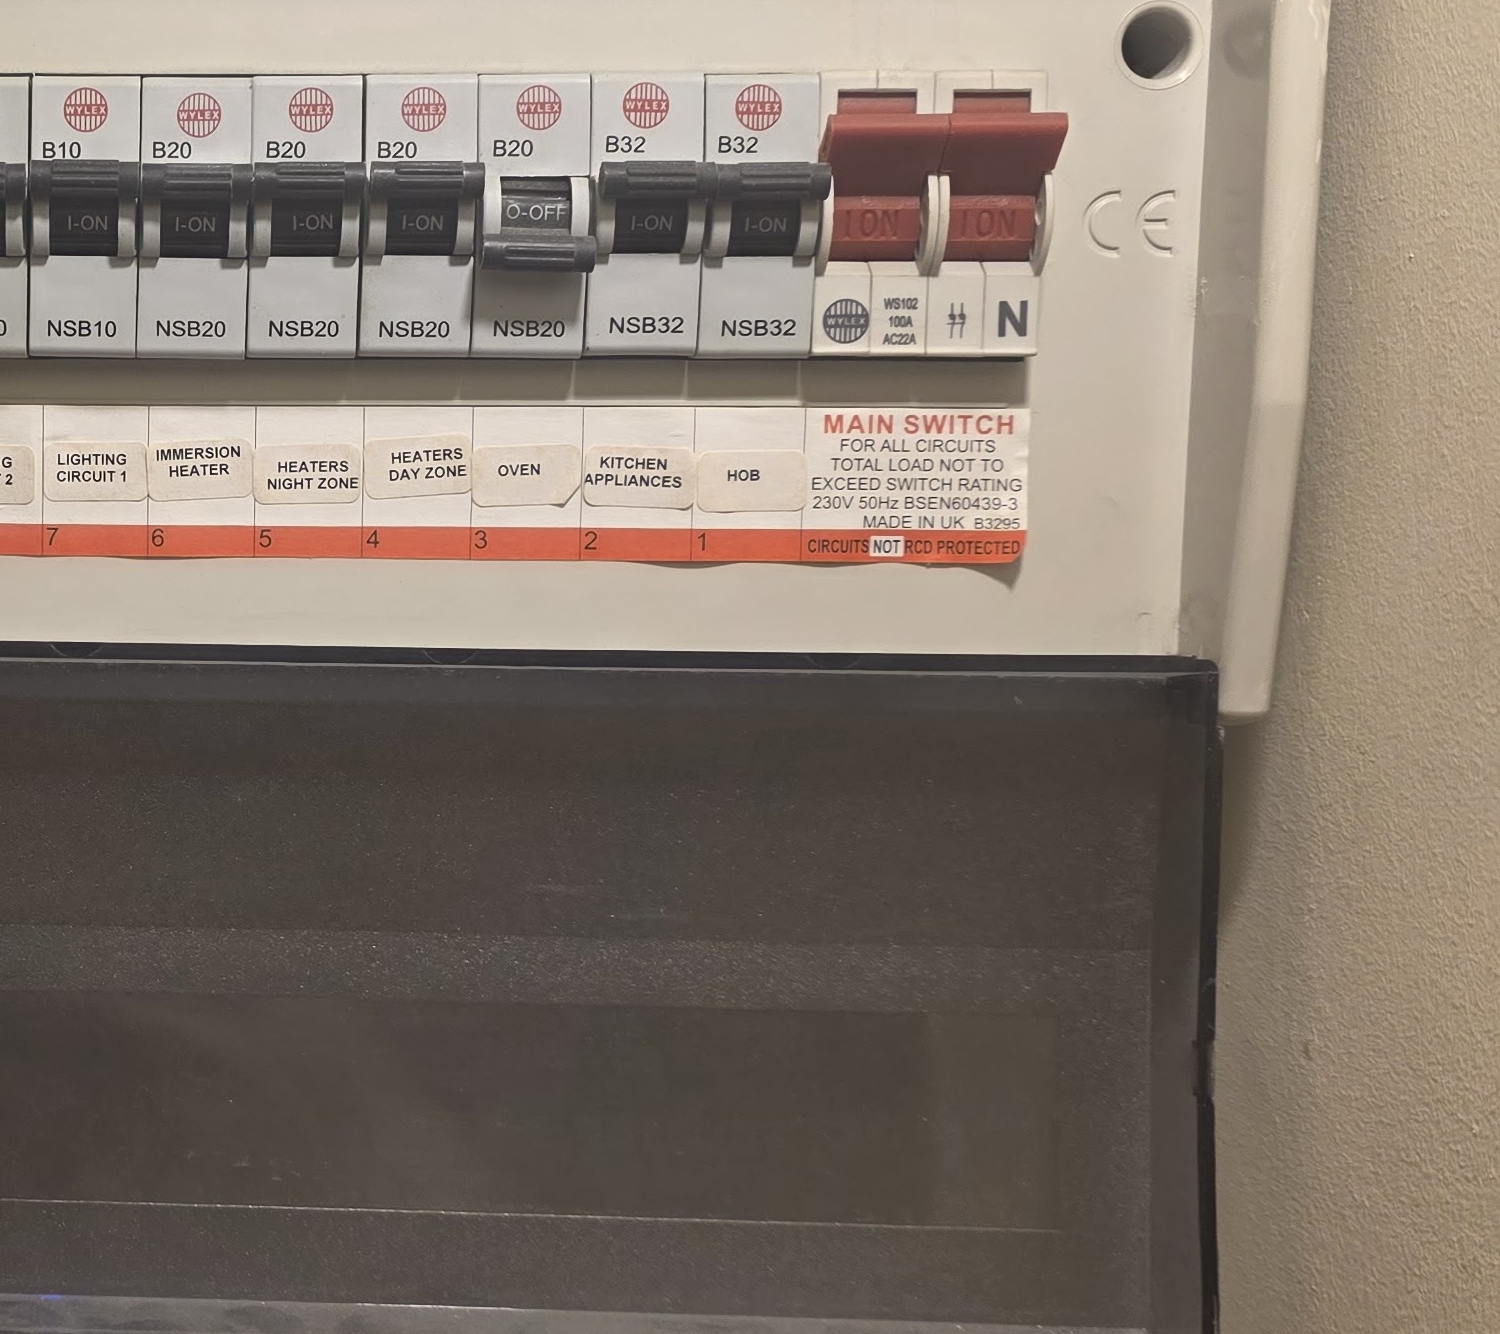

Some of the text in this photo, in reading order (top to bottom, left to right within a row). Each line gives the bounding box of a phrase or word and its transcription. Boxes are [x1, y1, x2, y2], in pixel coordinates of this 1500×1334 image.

[738, 103, 780, 113] WYLEX
[42, 141, 81, 158] B10
[152, 141, 192, 159] B20
[265, 140, 306, 158] B20
[377, 140, 418, 158] B20
[492, 139, 534, 157] B20
[605, 135, 646, 154] B32
[717, 135, 759, 154] B32
[883, 297, 919, 310] WS102
[609, 316, 684, 334] NSB32
[826, 316, 866, 326] WYLEX
[888, 315, 913, 328] 100A
[997, 300, 1029, 338] N
[47, 320, 117, 338] NSB10
[156, 320, 226, 338] NSB20
[268, 320, 340, 338] NSB20
[379, 320, 450, 338] NSB20
[493, 320, 565, 338] NSB20
[720, 319, 797, 337] NSB32
[882, 333, 917, 345] AC22A
[823, 414, 1015, 435] MAIN SWITCH
[155, 445, 241, 462] IMMERSION
[839, 438, 996, 453] FOR ALL CIRCUITS
[57, 453, 127, 466] LIGHTING
[391, 448, 464, 464] HEATERS
[600, 456, 668, 471] KITCHEN
[830, 457, 1005, 472] TOTAL LOAD NOT TO
[169, 463, 230, 478] HEATER
[277, 460, 349, 473] HEATERS
[389, 465, 467, 482] DAY ZONE
[497, 463, 541, 477] OVEN
[4, 473, 13, 486] 2
[56, 470, 127, 483] CIRCUIT 1
[267, 477, 359, 490] NIGHT ZONE
[584, 473, 682, 489] APPLIANCES
[727, 469, 760, 482] HOB
[811, 477, 1023, 492] EXCEED SWITCH RATING
[812, 496, 1019, 511] 230V 50Hz BSEN60439-3
[863, 515, 1021, 530] MADE IN UK B3295
[46, 527, 59, 547] 7
[151, 528, 165, 547] 6
[259, 529, 272, 548] 5
[366, 530, 380, 549] 4
[474, 530, 488, 549] 3
[584, 531, 598, 551] 2
[697, 532, 707, 551] 1
[807, 539, 1021, 555] CIRCUITS NOT RCD PROTECTED
